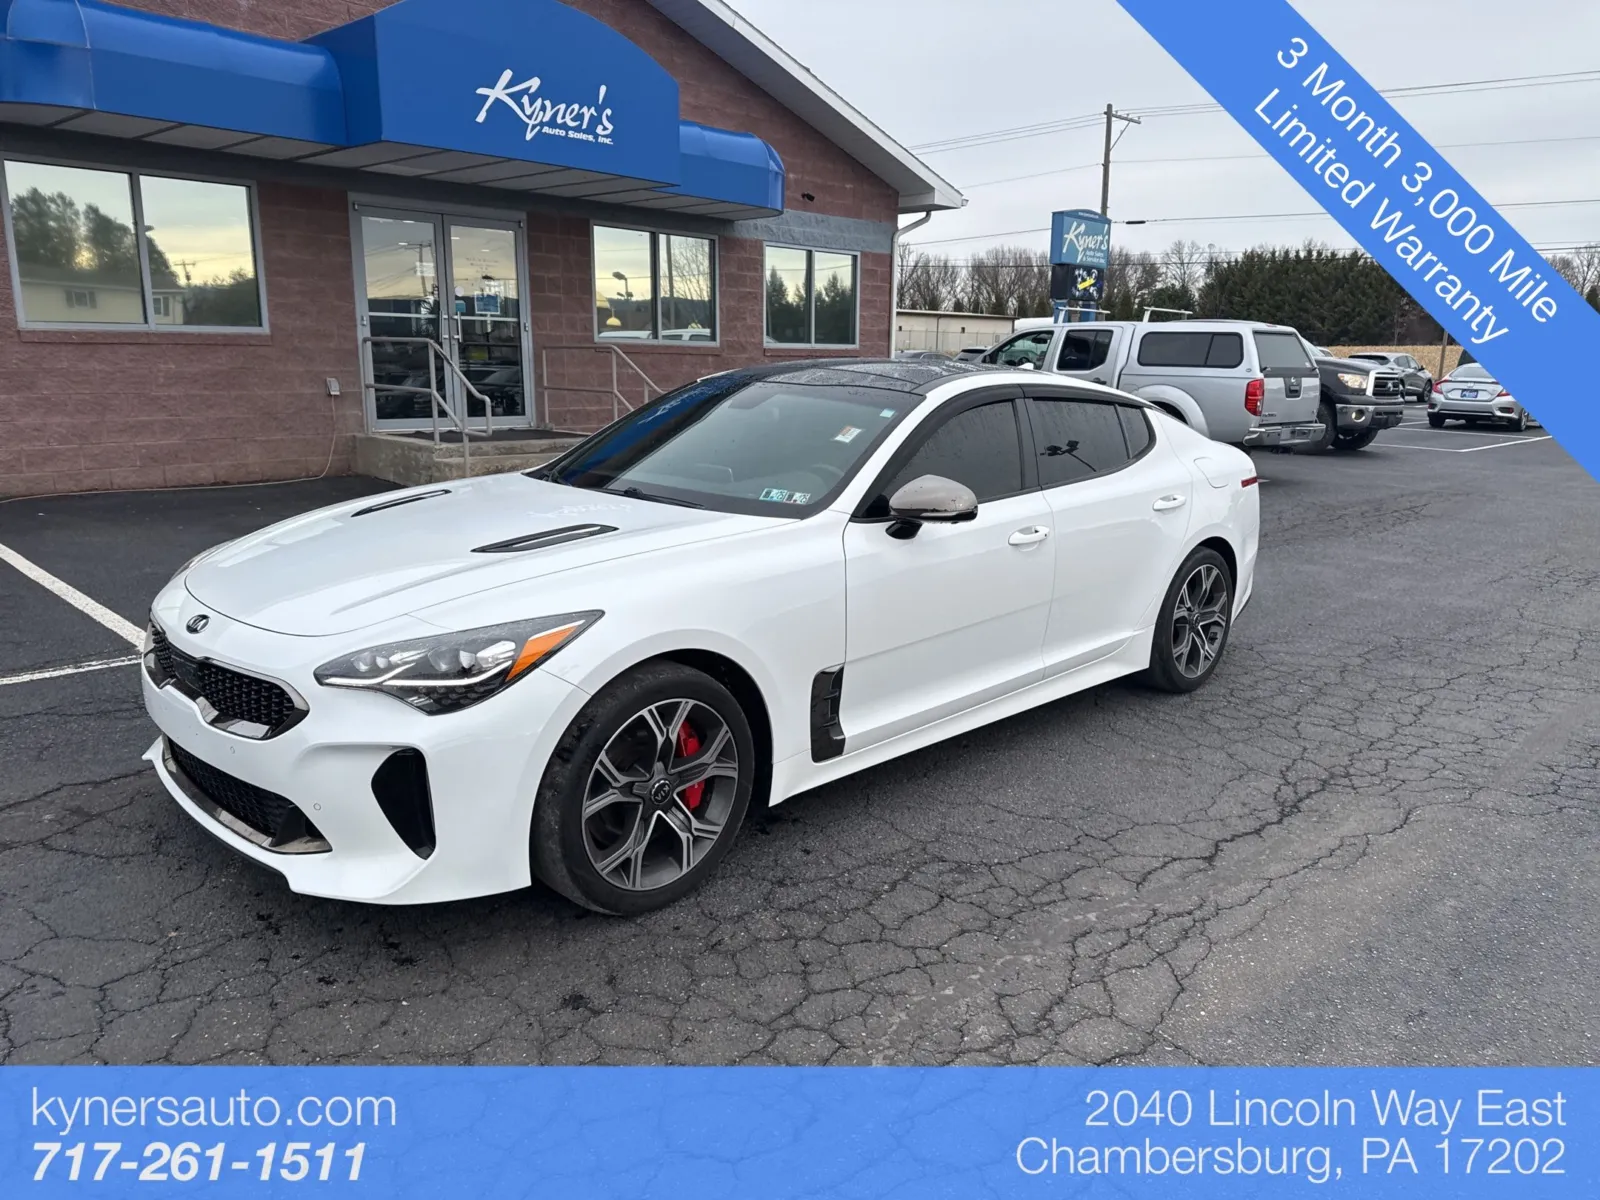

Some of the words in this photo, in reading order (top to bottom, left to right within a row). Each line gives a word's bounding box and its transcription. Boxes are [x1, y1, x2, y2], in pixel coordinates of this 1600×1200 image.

[475, 68, 614, 141] Kyner's
[541, 126, 566, 137] Auto
[567, 130, 596, 142] Sales,
[597, 136, 614, 145] Inc.
[1062, 220, 1109, 264] Kyner's
